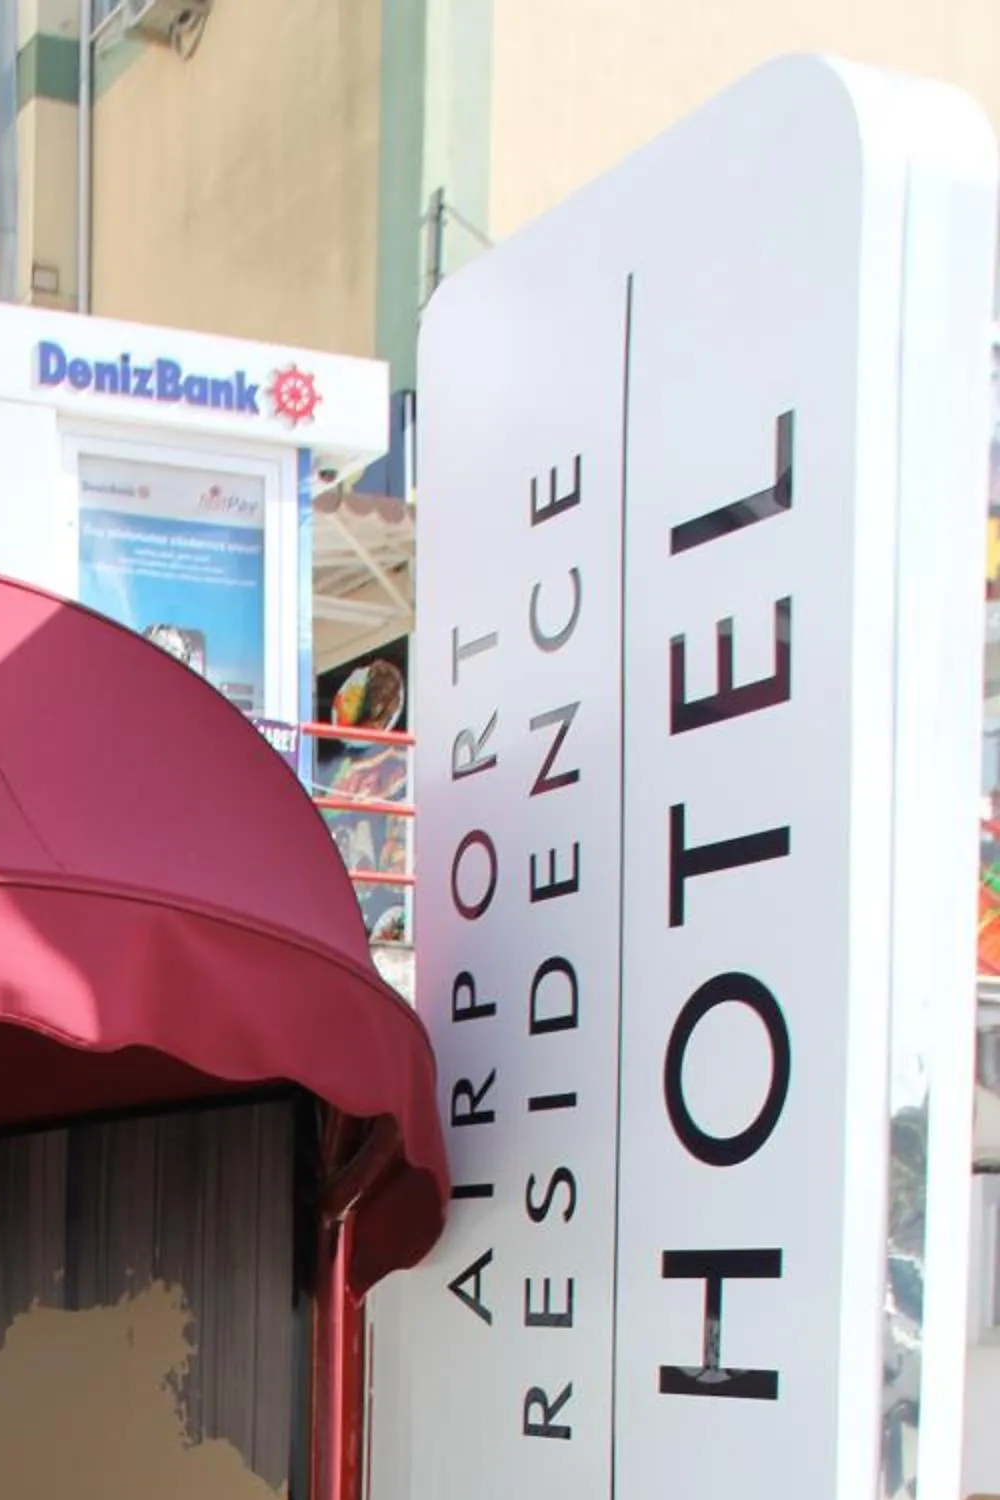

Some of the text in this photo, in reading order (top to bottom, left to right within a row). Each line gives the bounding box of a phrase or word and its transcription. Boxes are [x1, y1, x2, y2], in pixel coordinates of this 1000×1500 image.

[37, 341, 261, 415] DenizBank
[447, 626, 498, 1326] AIRPORT
[523, 453, 582, 1440] RESIDENCE
[659, 409, 794, 1400] HOTEL
